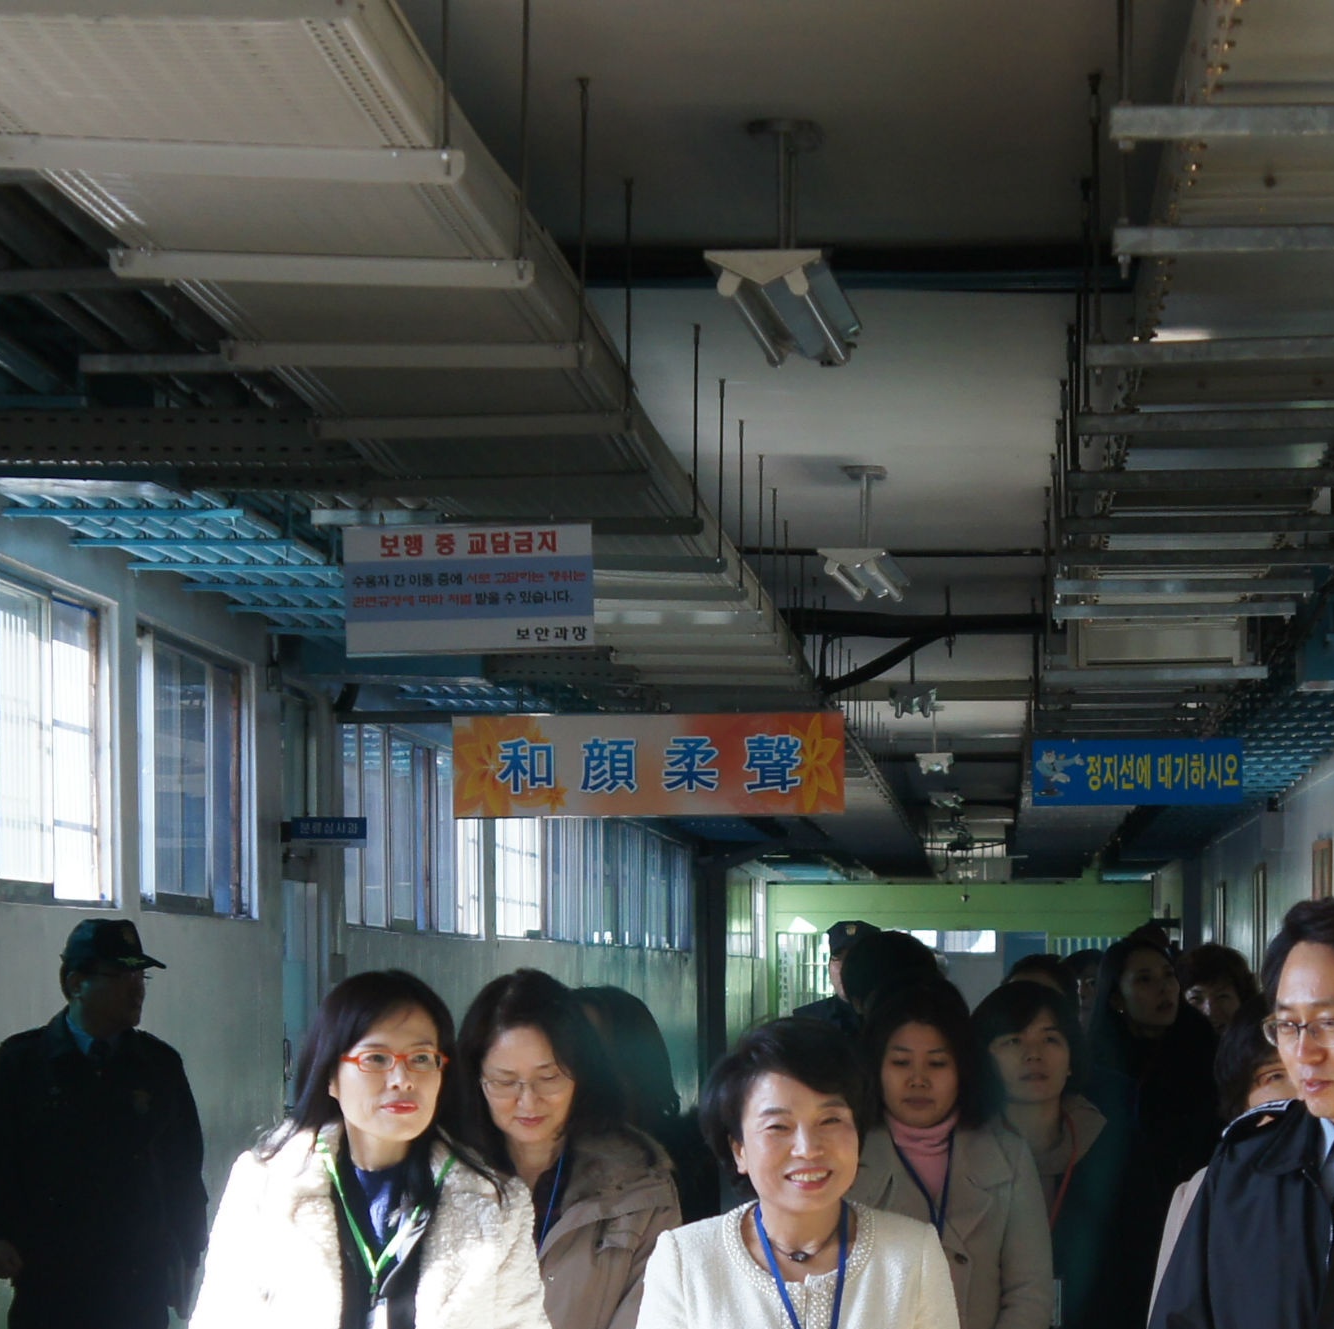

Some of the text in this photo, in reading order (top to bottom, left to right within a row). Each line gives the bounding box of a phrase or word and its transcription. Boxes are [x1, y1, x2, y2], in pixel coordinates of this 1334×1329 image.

[380, 530, 558, 558] 보행 중 교담금지
[352, 573, 389, 588] 수용자
[393, 572, 406, 587] 간
[409, 573, 433, 587] 이동
[437, 570, 463, 586] 중에
[475, 591, 500, 606] 받을
[504, 592, 517, 605] 수
[516, 625, 588, 643] 보안과장
[1086, 753, 1240, 791] 정지선에 대기하시오
